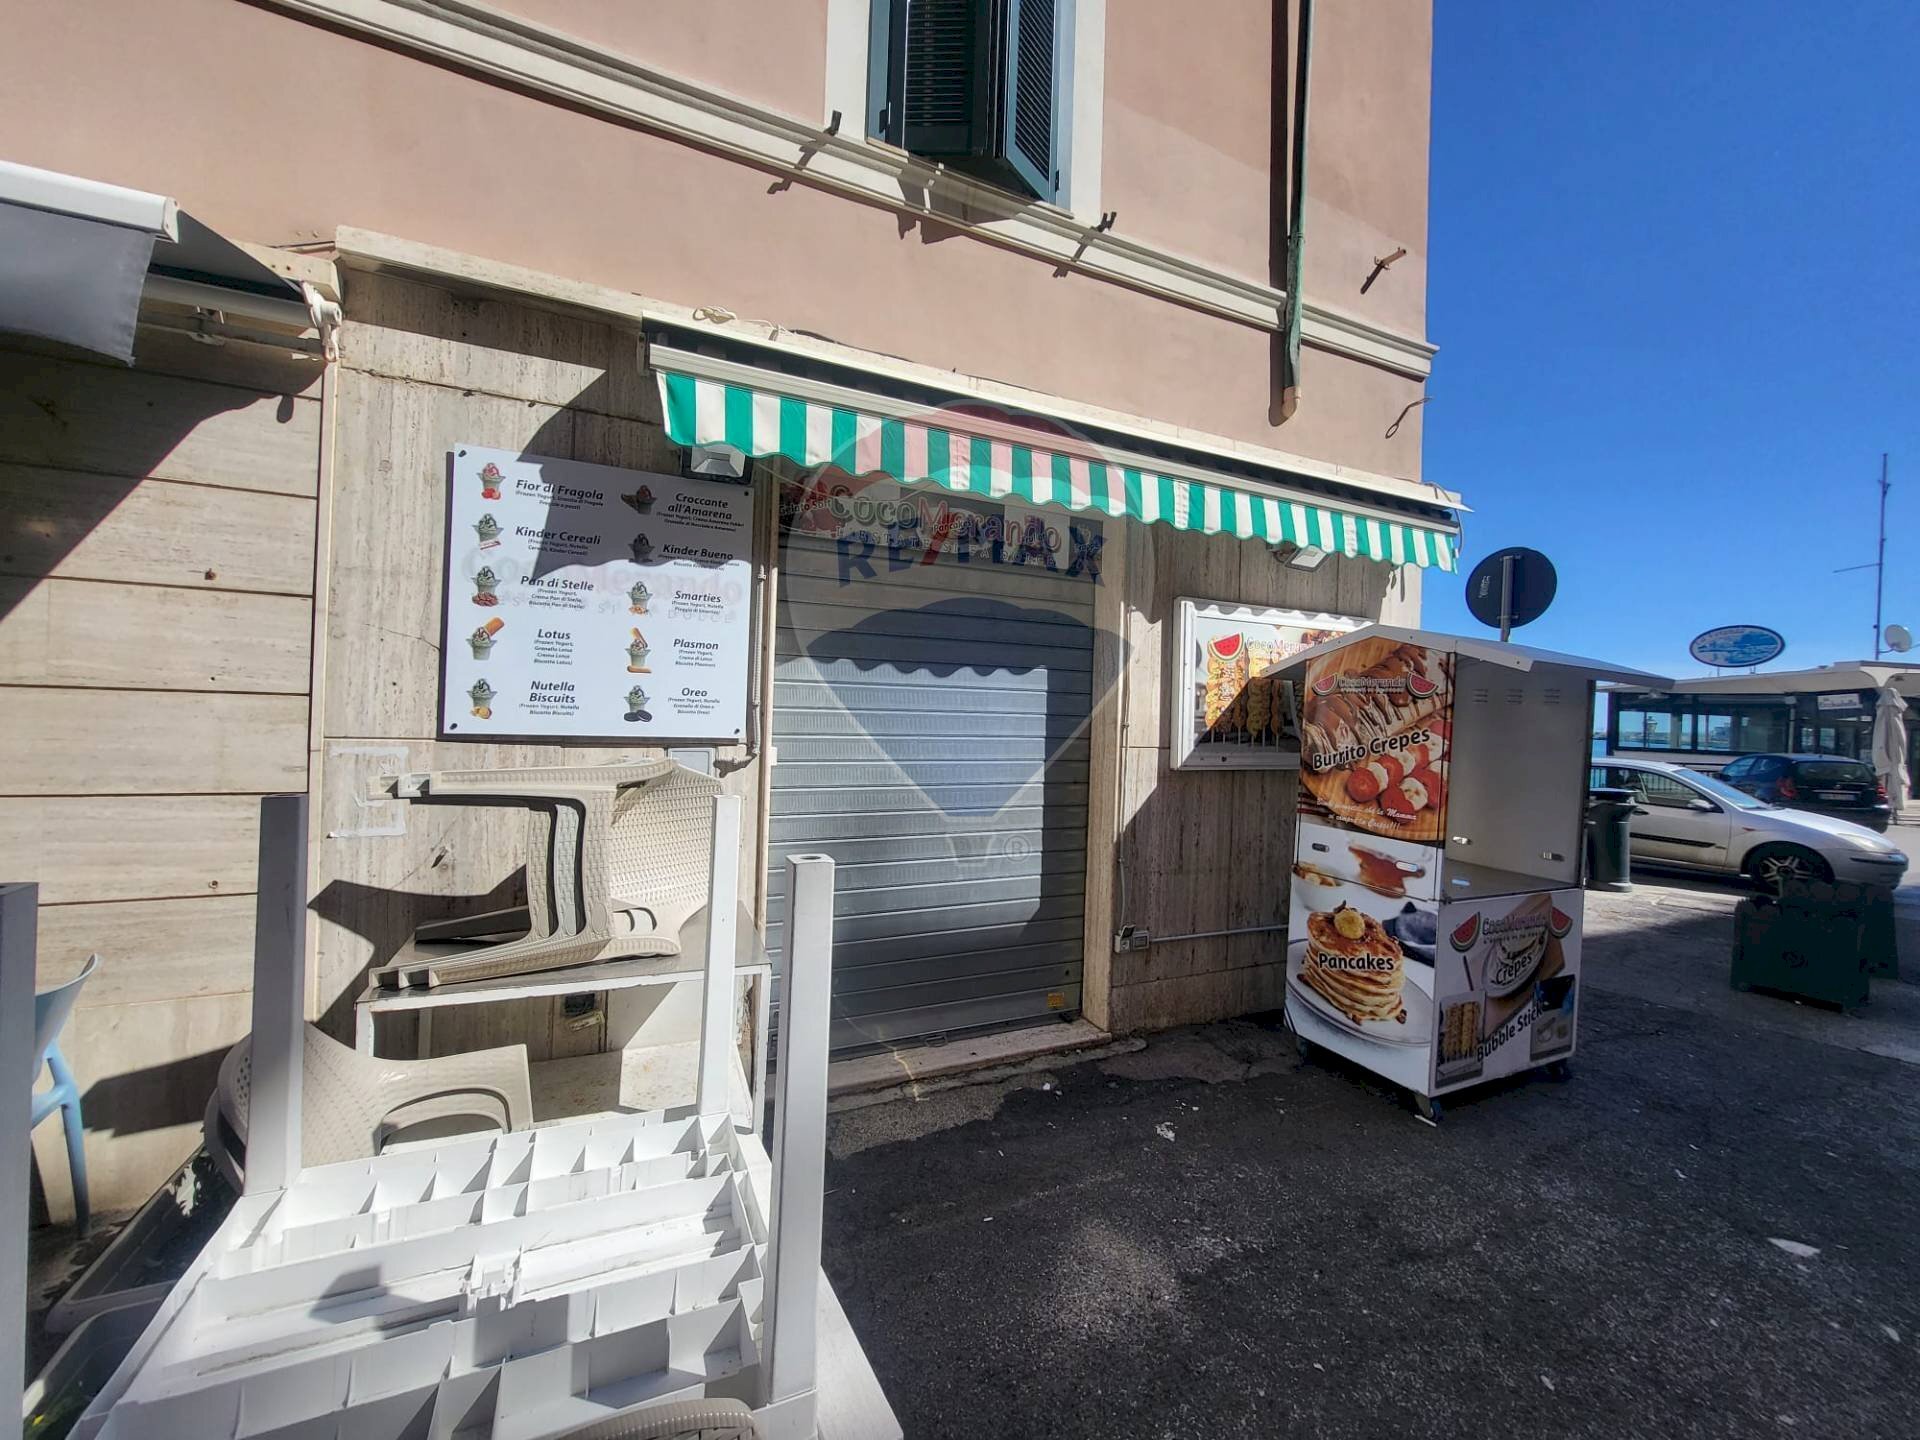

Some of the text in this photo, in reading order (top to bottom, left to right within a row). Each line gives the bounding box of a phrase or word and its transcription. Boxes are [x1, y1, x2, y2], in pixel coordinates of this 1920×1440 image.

[516, 479, 604, 500] Fior di Fragola
[675, 492, 729, 509] Croccante
[667, 503, 733, 520] all'Amarena
[515, 526, 601, 545] Kinder Cereali
[662, 543, 700, 556] Kinder
[700, 548, 734, 560] Bueno
[520, 575, 594, 591] Pan di Stelle
[674, 590, 722, 603] Smarties
[537, 628, 571, 640] Lotus
[673, 638, 719, 650] Plasmon
[530, 680, 575, 692] Nutella
[681, 687, 708, 697] Oreo
[529, 692, 576, 704] Biscuits
[1313, 728, 1431, 771] Burrito Crepes
[1318, 952, 1395, 972] Pancakes
[1496, 952, 1533, 985] Crepes
[1476, 1023, 1516, 1062] Bubble
